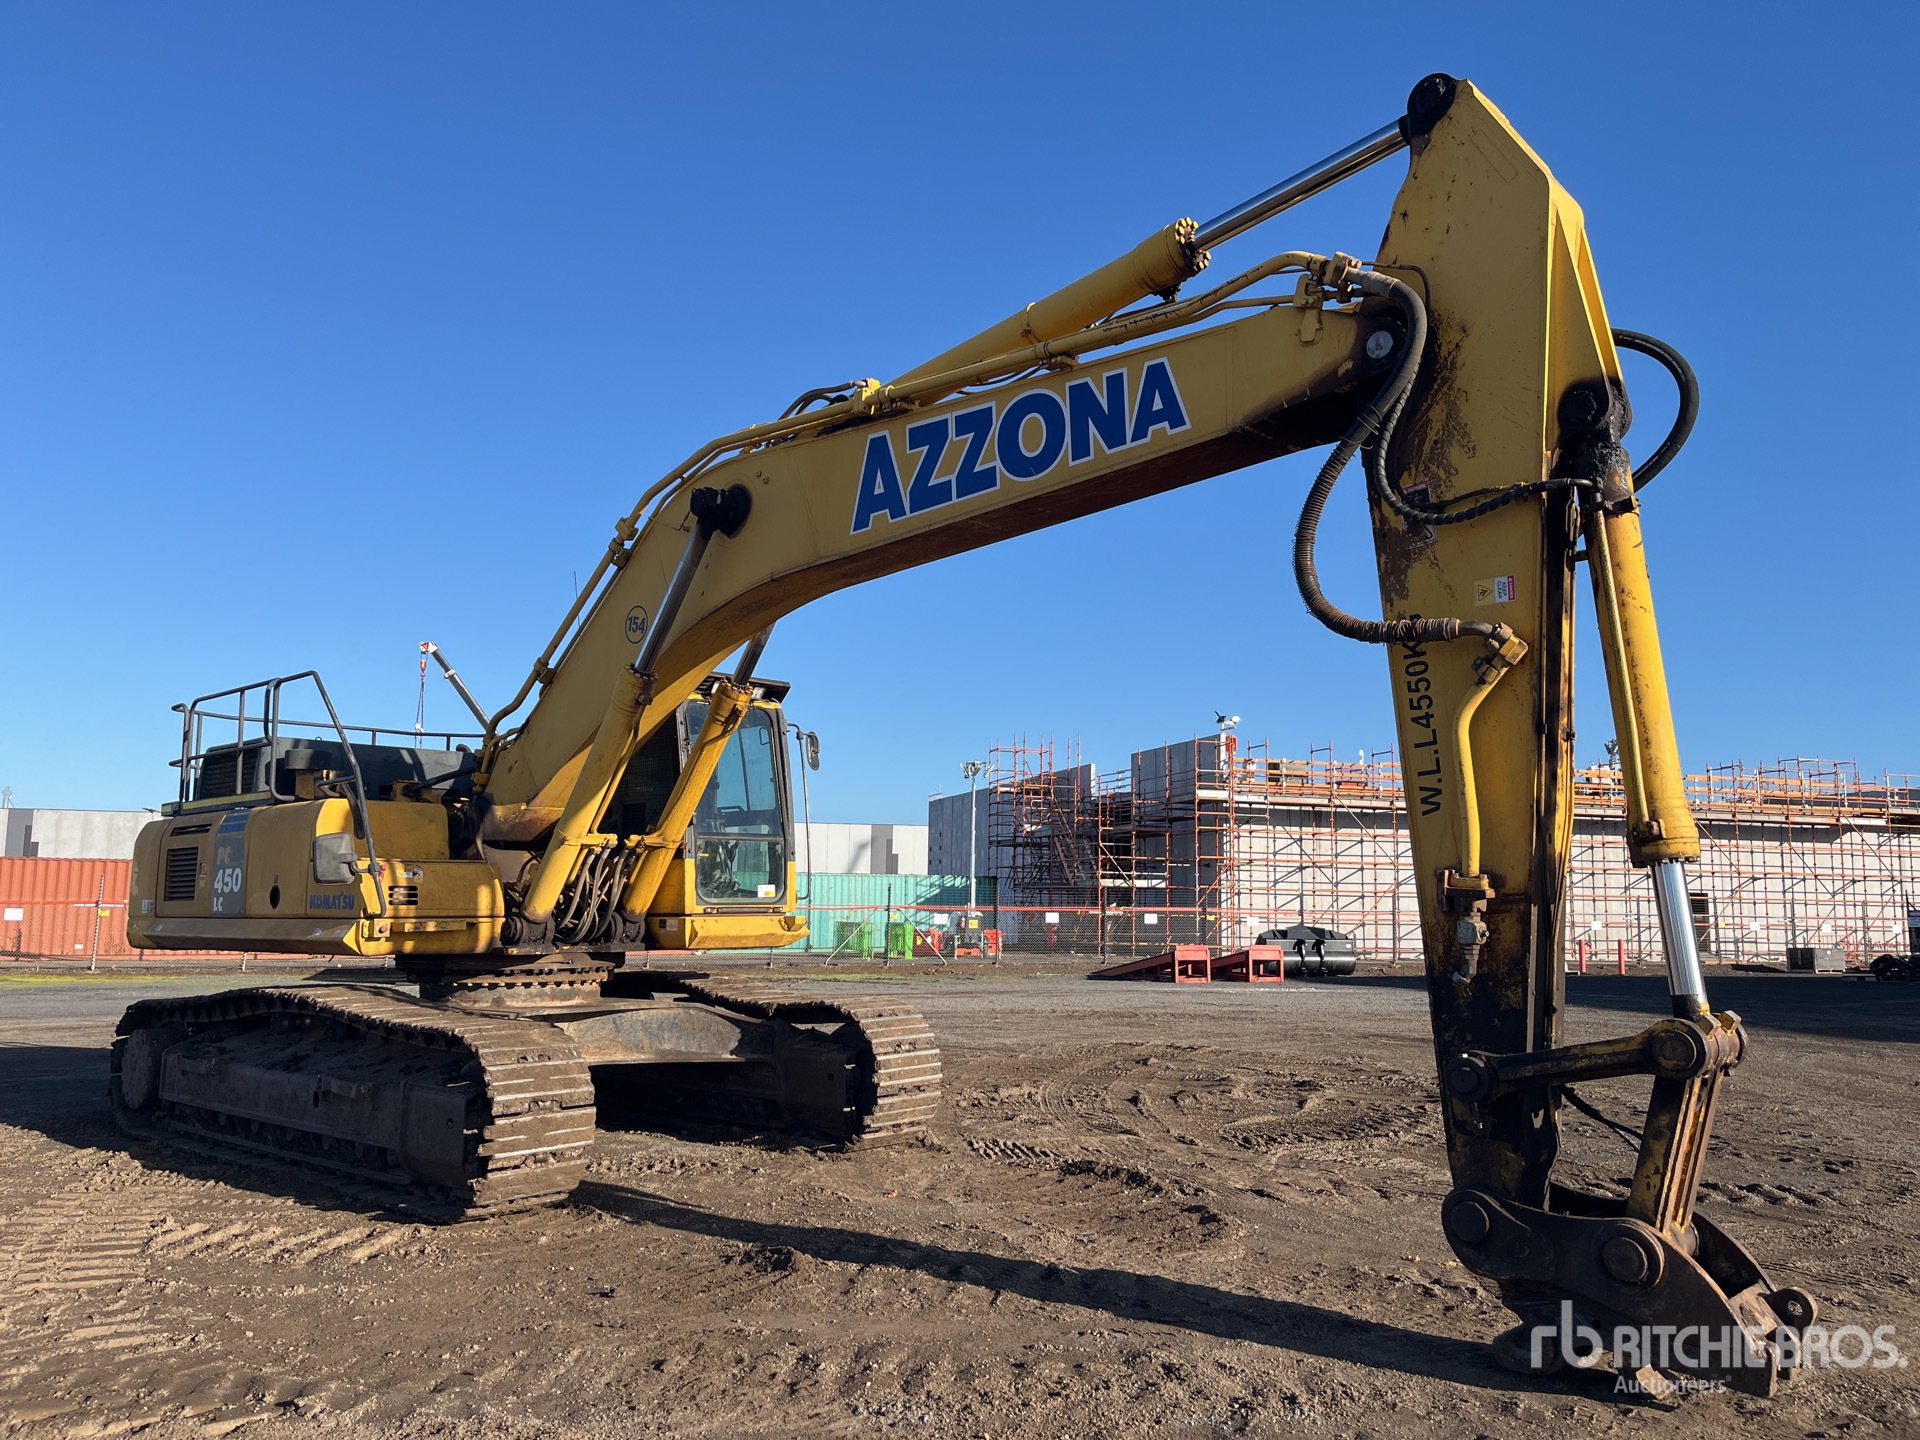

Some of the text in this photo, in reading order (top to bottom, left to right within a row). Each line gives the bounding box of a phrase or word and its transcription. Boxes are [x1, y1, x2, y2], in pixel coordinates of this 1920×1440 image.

[850, 356, 1192, 535] AZZONA
[628, 616, 646, 634] 154
[1402, 613, 1443, 816] W.L.L4550K
[217, 846, 231, 865] PC
[214, 867, 242, 893] 450
[213, 897, 223, 911] LC
[309, 890, 355, 910] KOMATSU
